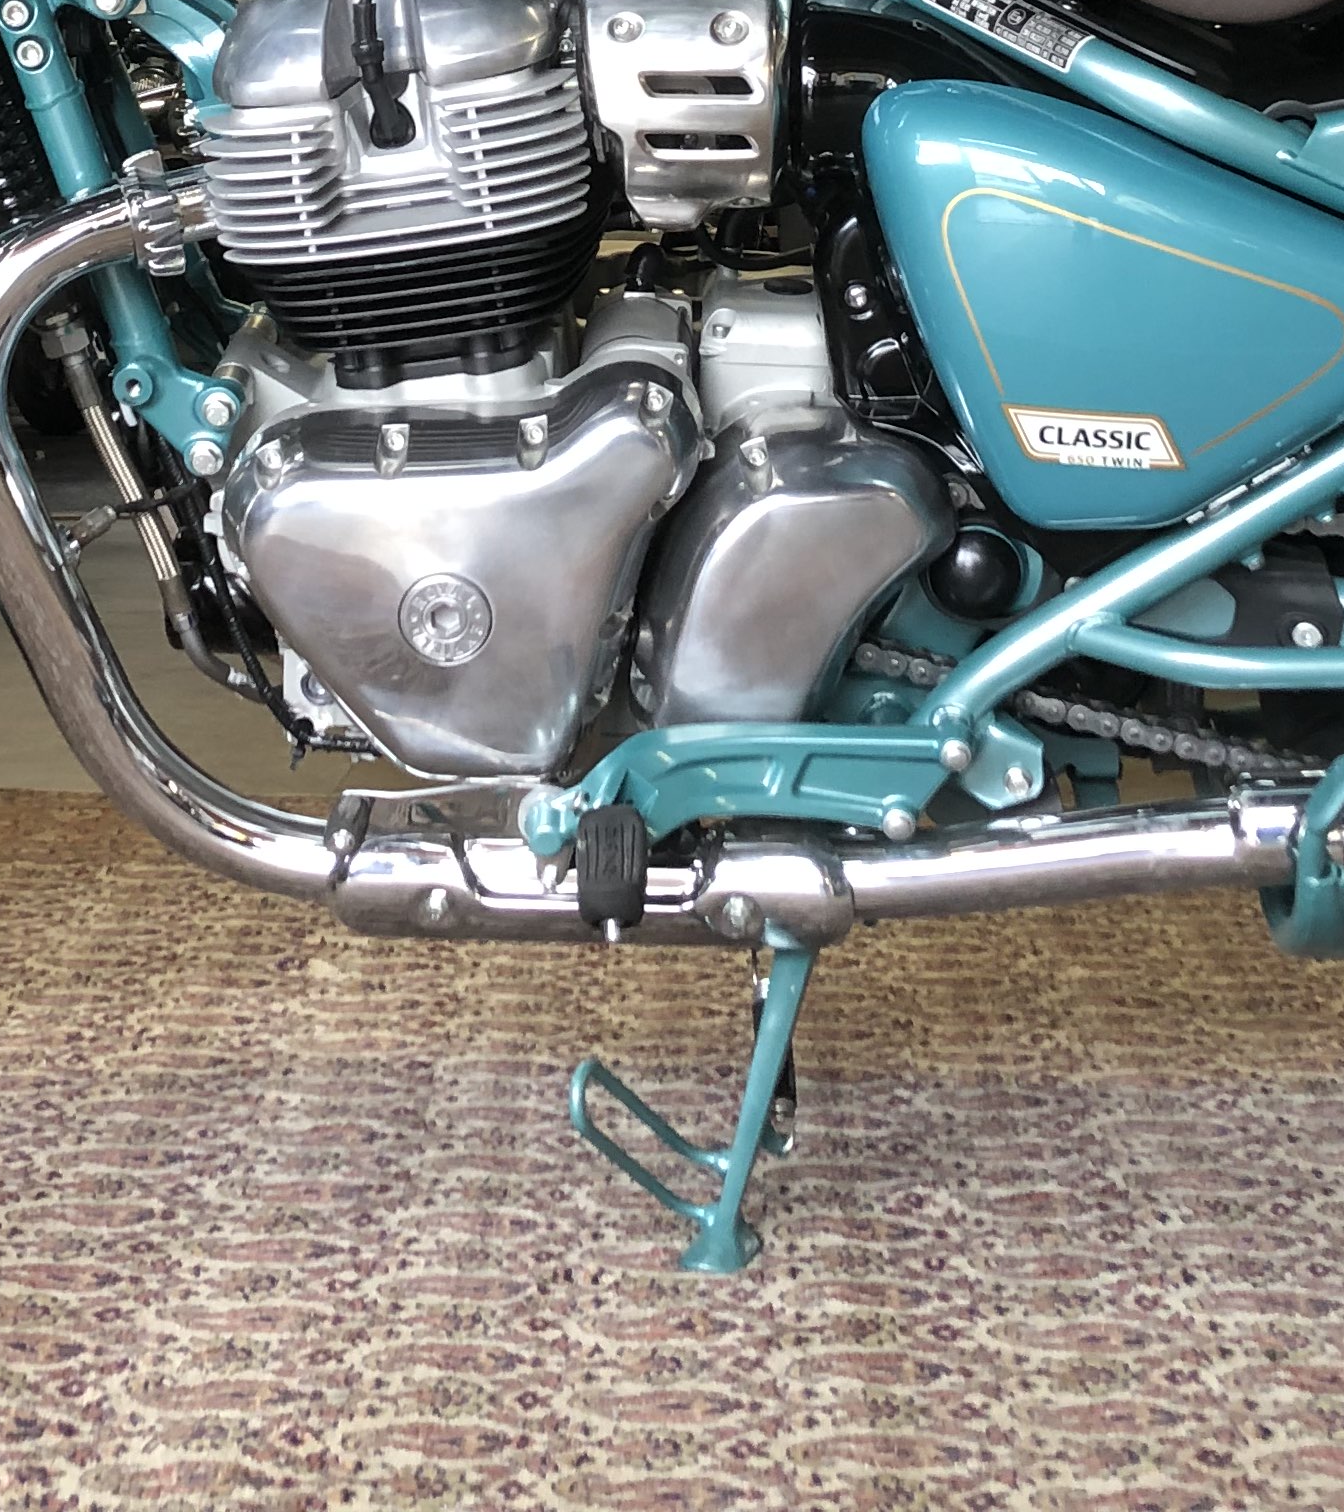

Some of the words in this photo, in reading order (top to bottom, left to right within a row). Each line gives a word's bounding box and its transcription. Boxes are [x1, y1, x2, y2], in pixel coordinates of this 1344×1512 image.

[1038, 425, 1152, 451] CLASSIC
[1067, 454, 1096, 465] 650
[1101, 455, 1144, 468] TWIN
